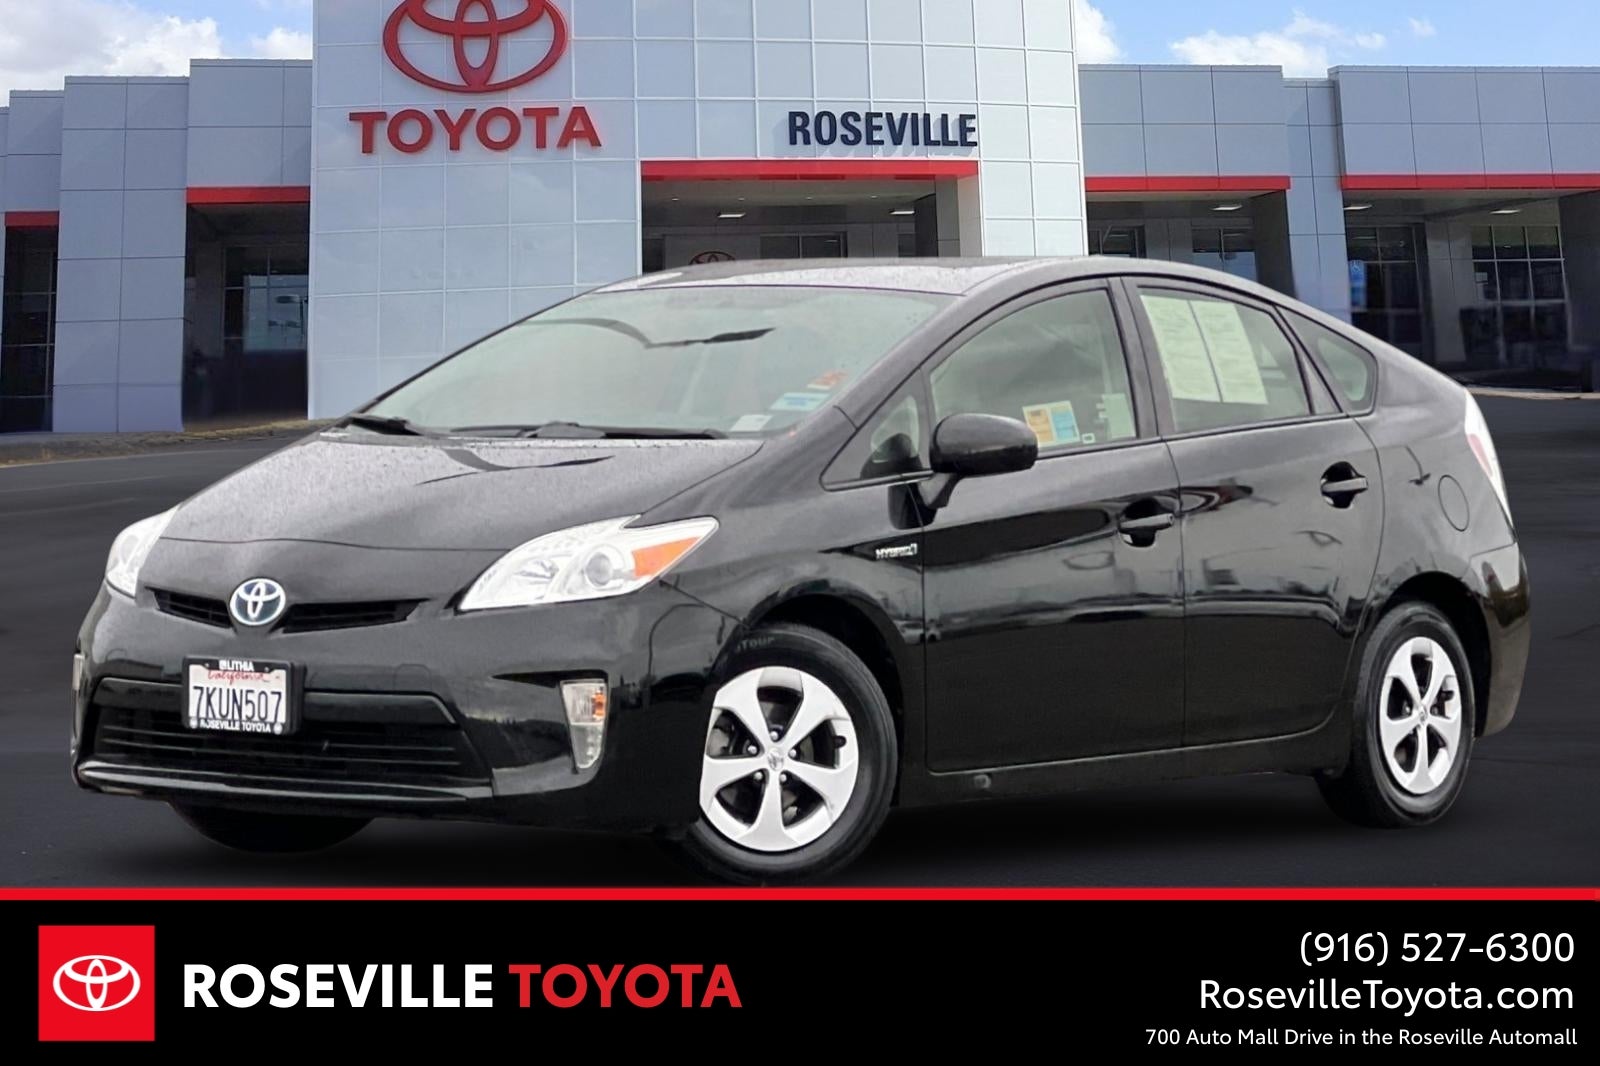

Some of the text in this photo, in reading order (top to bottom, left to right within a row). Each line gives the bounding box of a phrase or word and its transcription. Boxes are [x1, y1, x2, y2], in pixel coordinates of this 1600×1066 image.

[349, 106, 602, 154] TOYOTA
[788, 111, 978, 147] ROSEVILLE
[227, 660, 255, 671] LITHIA
[193, 686, 282, 724] 7KUN507
[200, 719, 271, 733] ROSEVILLE TOYOTA
